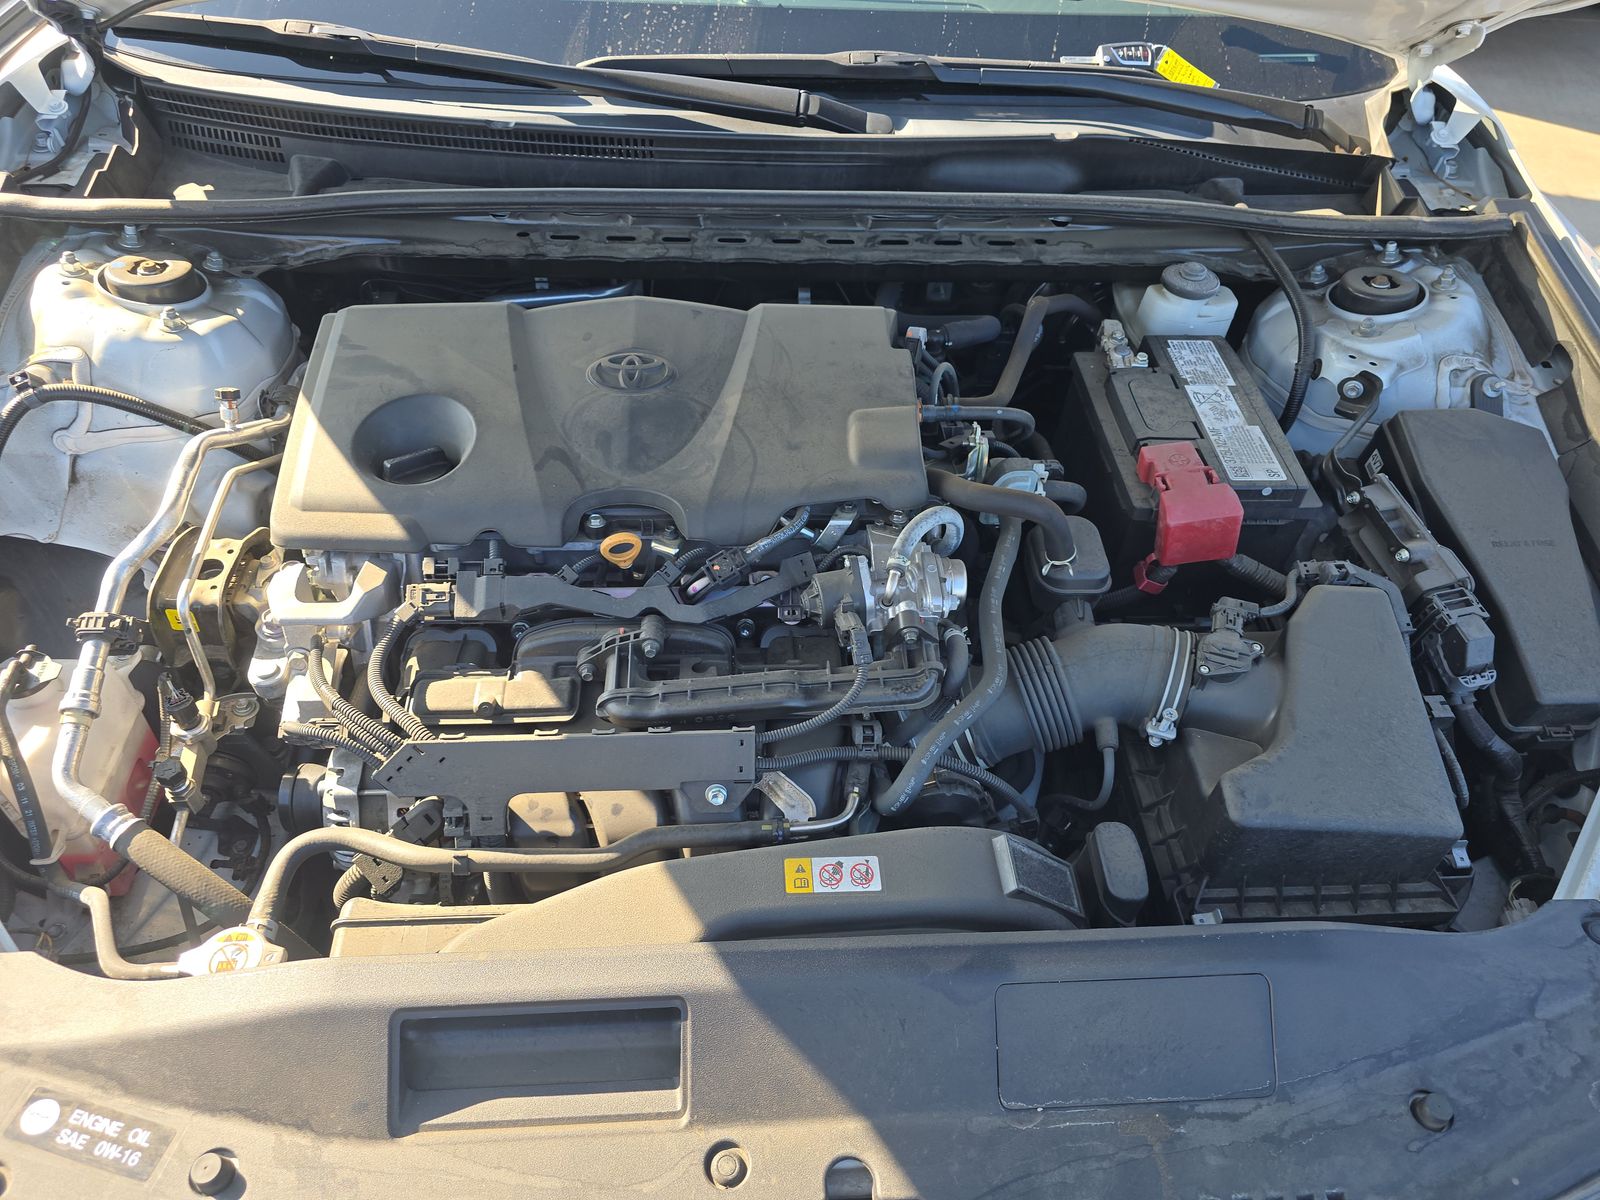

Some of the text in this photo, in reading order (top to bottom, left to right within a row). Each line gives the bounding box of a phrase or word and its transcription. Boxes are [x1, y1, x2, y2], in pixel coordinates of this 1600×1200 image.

[68, 1108, 151, 1147] ENGINE OIL
[55, 1128, 142, 1166] SAE 0W-16
